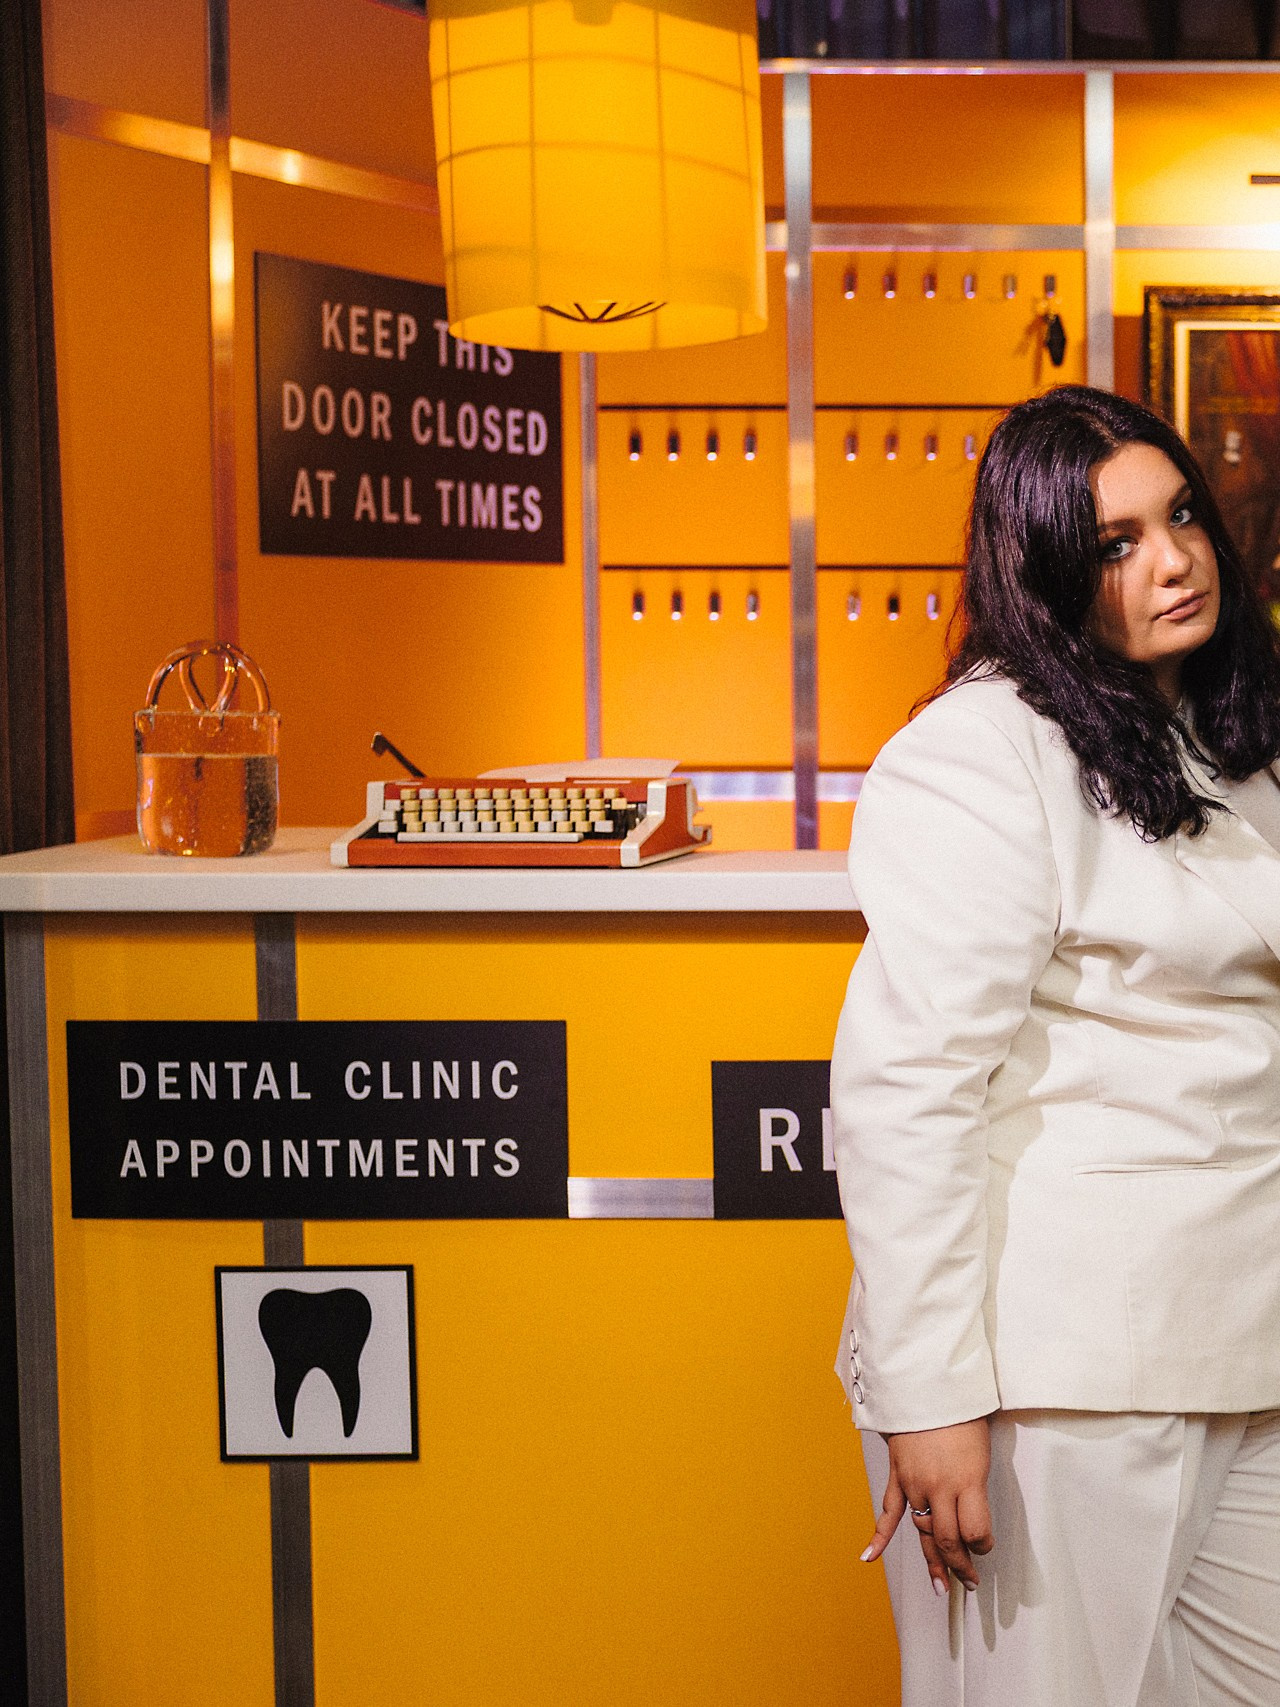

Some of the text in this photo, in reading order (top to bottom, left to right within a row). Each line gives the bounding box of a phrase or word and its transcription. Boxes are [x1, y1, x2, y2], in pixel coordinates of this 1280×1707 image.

[322, 302, 417, 360] KEEP
[283, 381, 548, 456] DOOR CLOSED
[291, 468, 542, 532] AT ALL TIMES
[119, 1059, 519, 1100] DENTAL CLINIC
[120, 1137, 520, 1178] APPOINTMENTS
